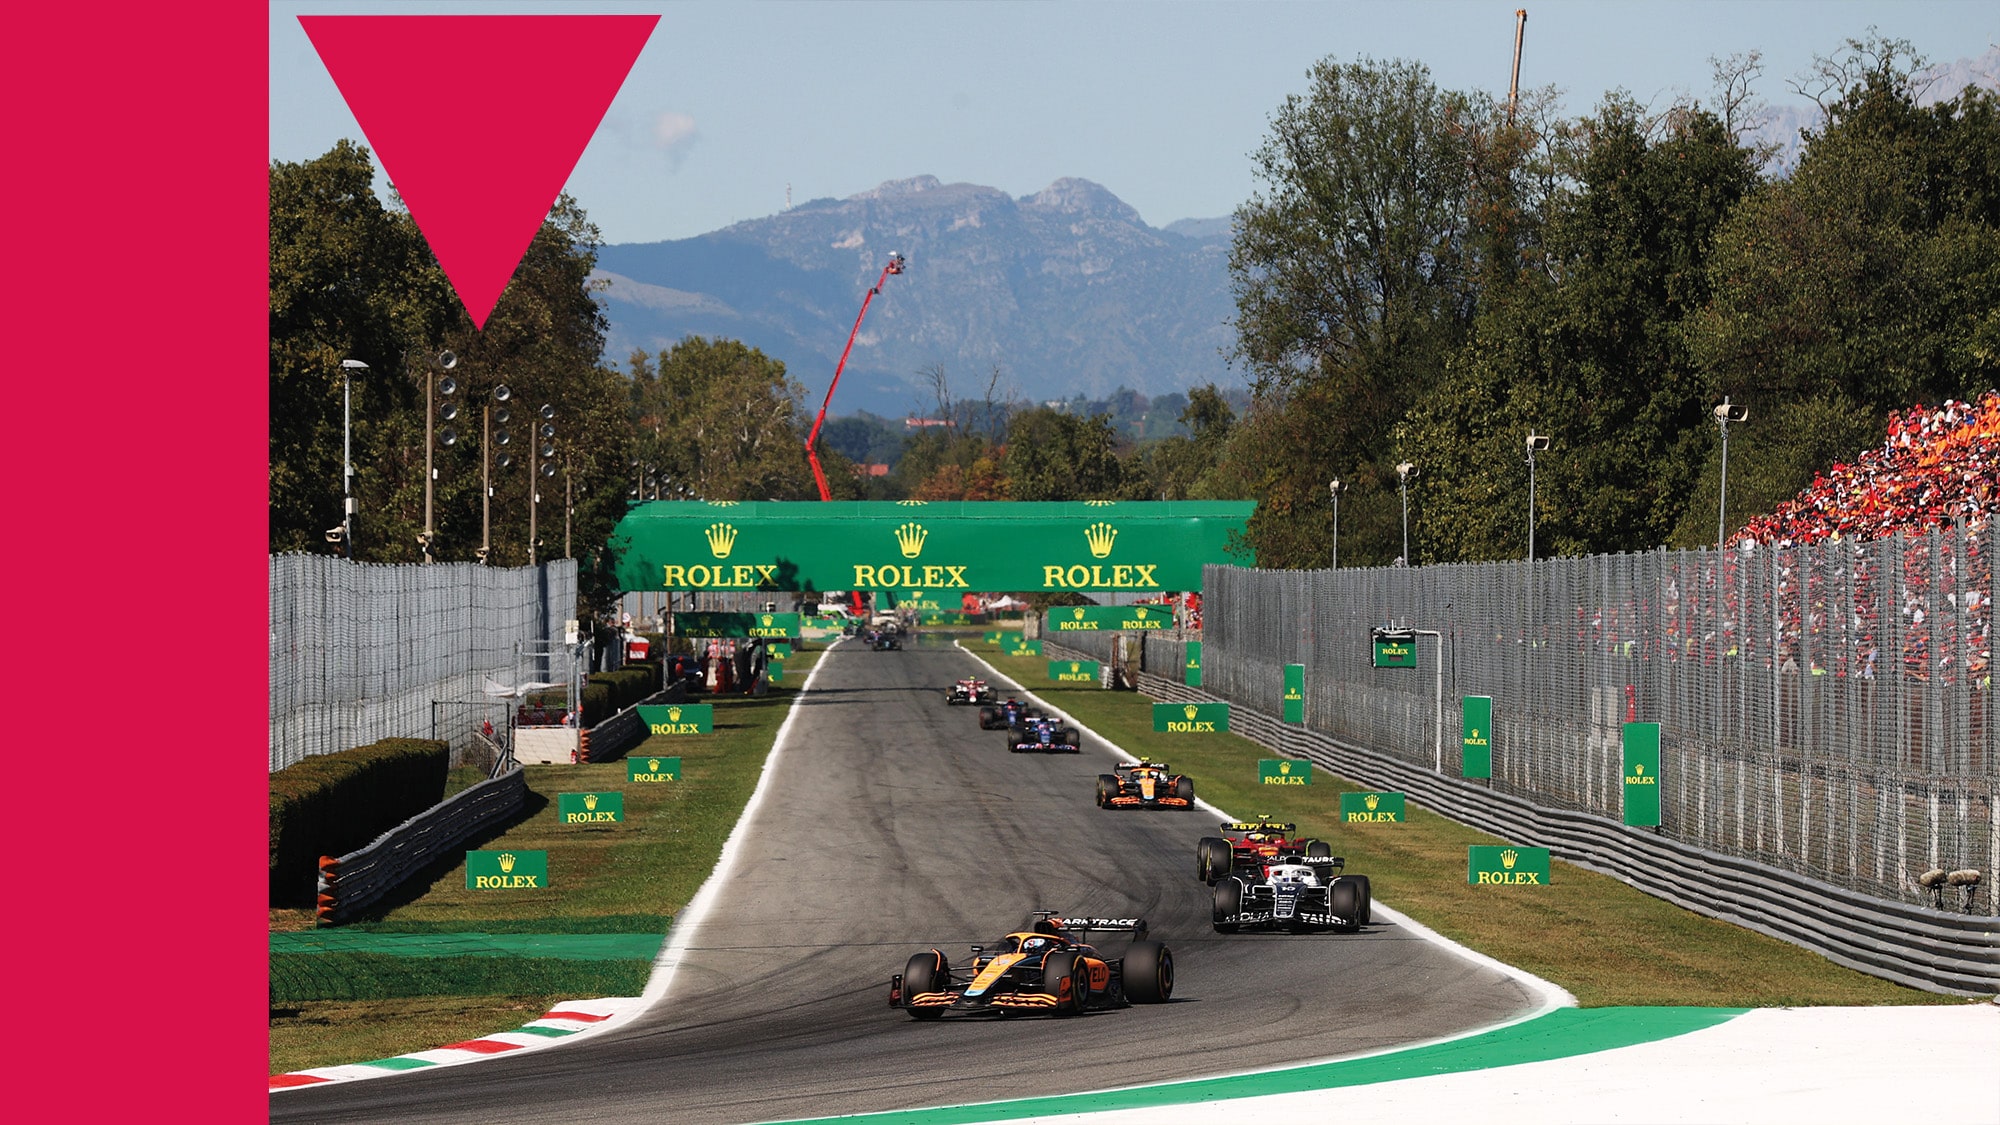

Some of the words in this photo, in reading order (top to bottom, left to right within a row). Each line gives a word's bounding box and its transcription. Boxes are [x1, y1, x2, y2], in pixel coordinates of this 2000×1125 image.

[664, 564, 777, 588] ROLEX
[854, 564, 968, 588] ROLEX
[1044, 564, 1158, 588] ROLEX
[1060, 621, 1098, 630] ROLEX
[1122, 620, 1161, 629] ROLEX
[748, 628, 787, 637] ROLEX
[1058, 673, 1091, 681] ROLEX
[651, 724, 700, 735] ROLEX
[1167, 721, 1215, 732] ROLEX
[1464, 737, 1487, 746] ROLEX
[633, 772, 674, 783] ROLEX
[1264, 775, 1305, 785] ROLEX
[1625, 775, 1655, 785] ROLEX
[566, 811, 616, 823] ROLEX
[1347, 811, 1397, 823] ROLEX
[476, 875, 538, 889] ROLEX
[1477, 871, 1540, 886] ROLEX
